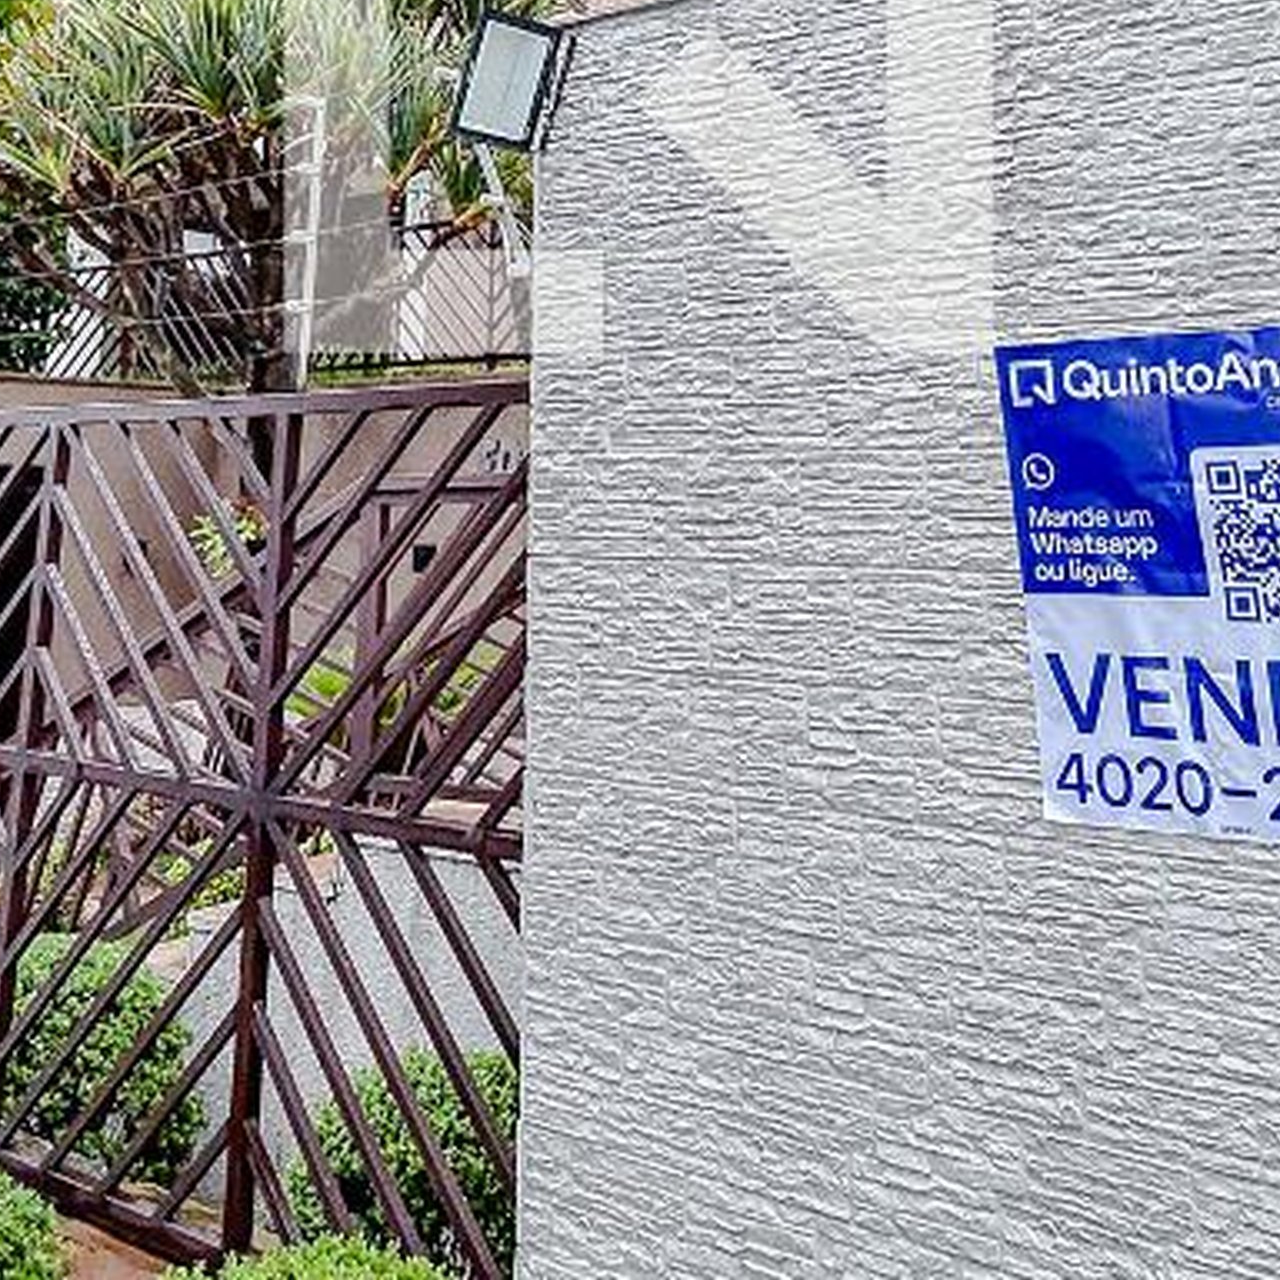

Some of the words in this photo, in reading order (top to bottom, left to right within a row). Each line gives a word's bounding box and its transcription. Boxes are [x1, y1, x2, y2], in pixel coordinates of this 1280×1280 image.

[1028, 506, 1109, 529] Mande
[1115, 509, 1155, 528] um
[1029, 532, 1158, 560] Whatsapp
[1035, 563, 1065, 581] ou
[1068, 558, 1137, 588] ligue.
